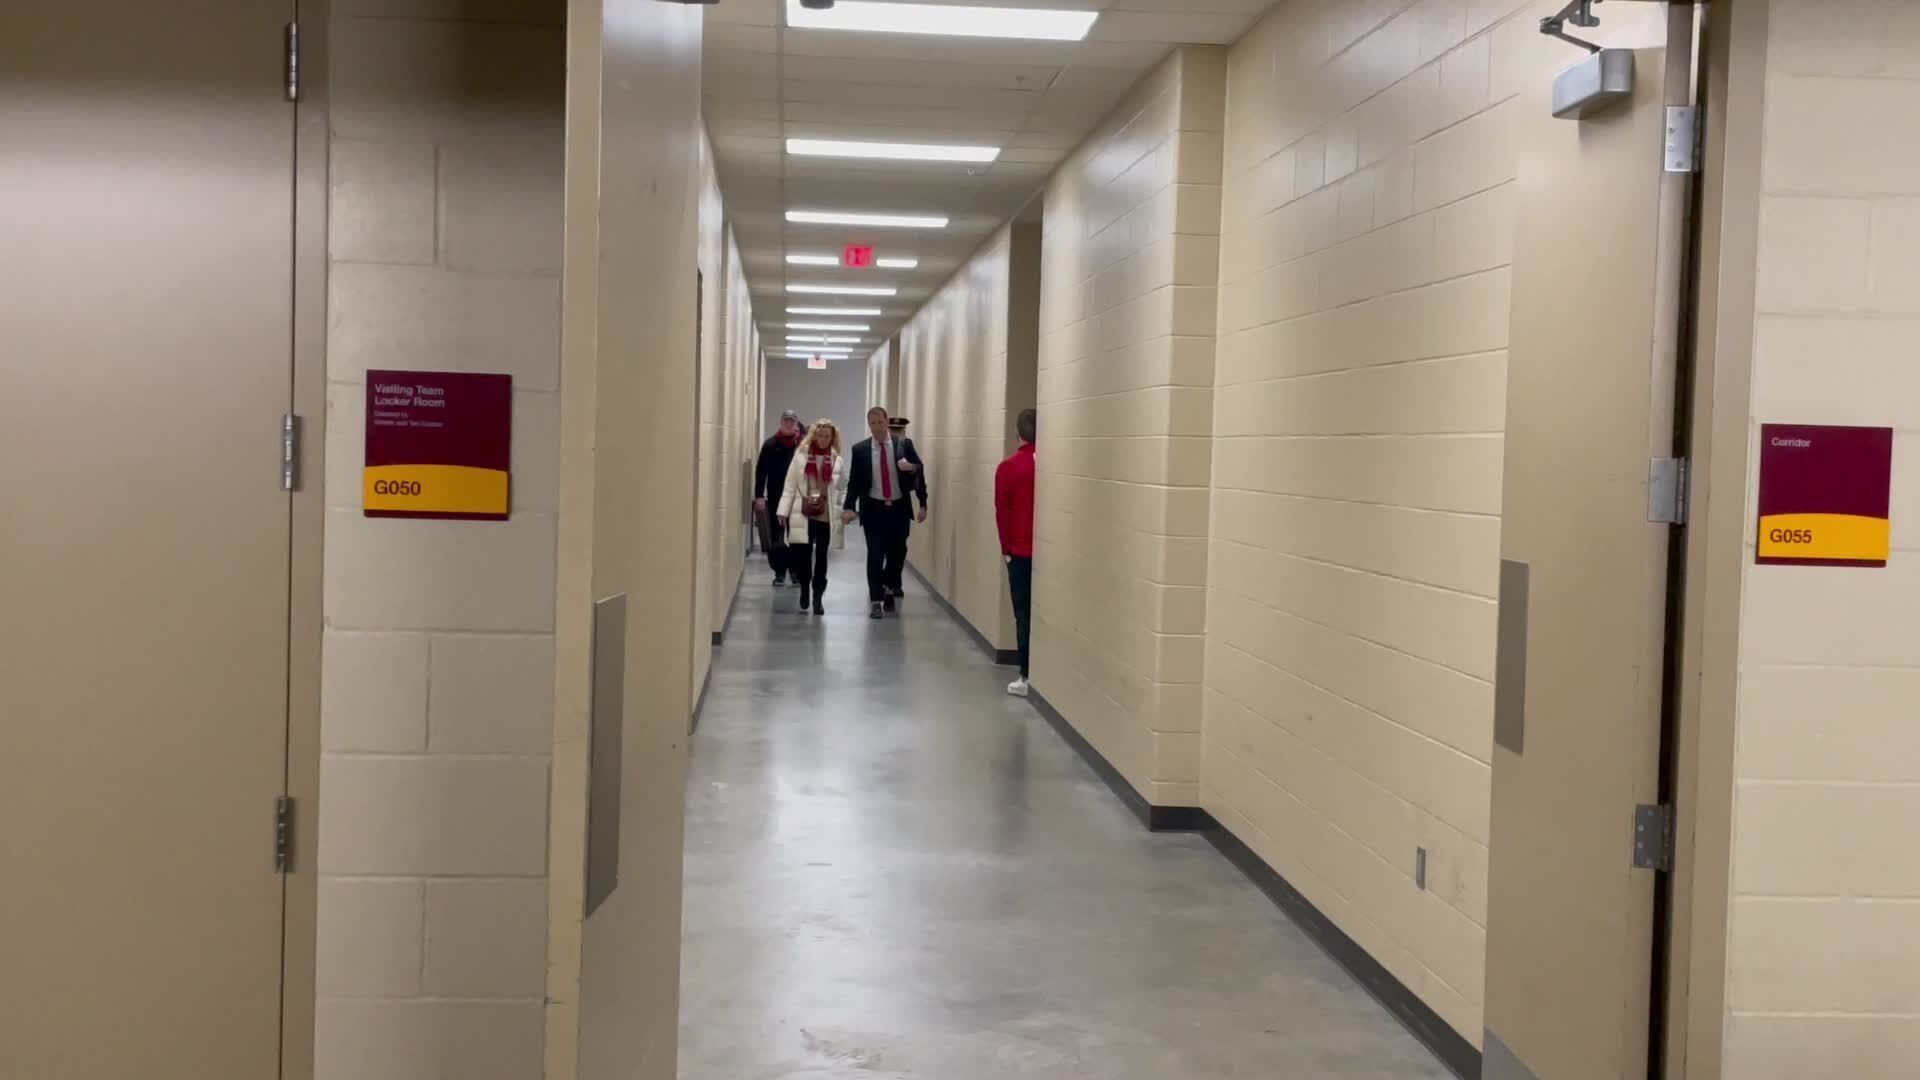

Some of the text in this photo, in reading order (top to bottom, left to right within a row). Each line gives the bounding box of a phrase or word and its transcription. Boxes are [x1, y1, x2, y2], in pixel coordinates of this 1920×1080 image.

[374, 383, 444, 397] Visiting Team
[374, 395, 445, 408] Locker Room
[1771, 437, 1811, 447] Corridor
[374, 480, 421, 496] G050
[1770, 528, 1812, 544] G055
